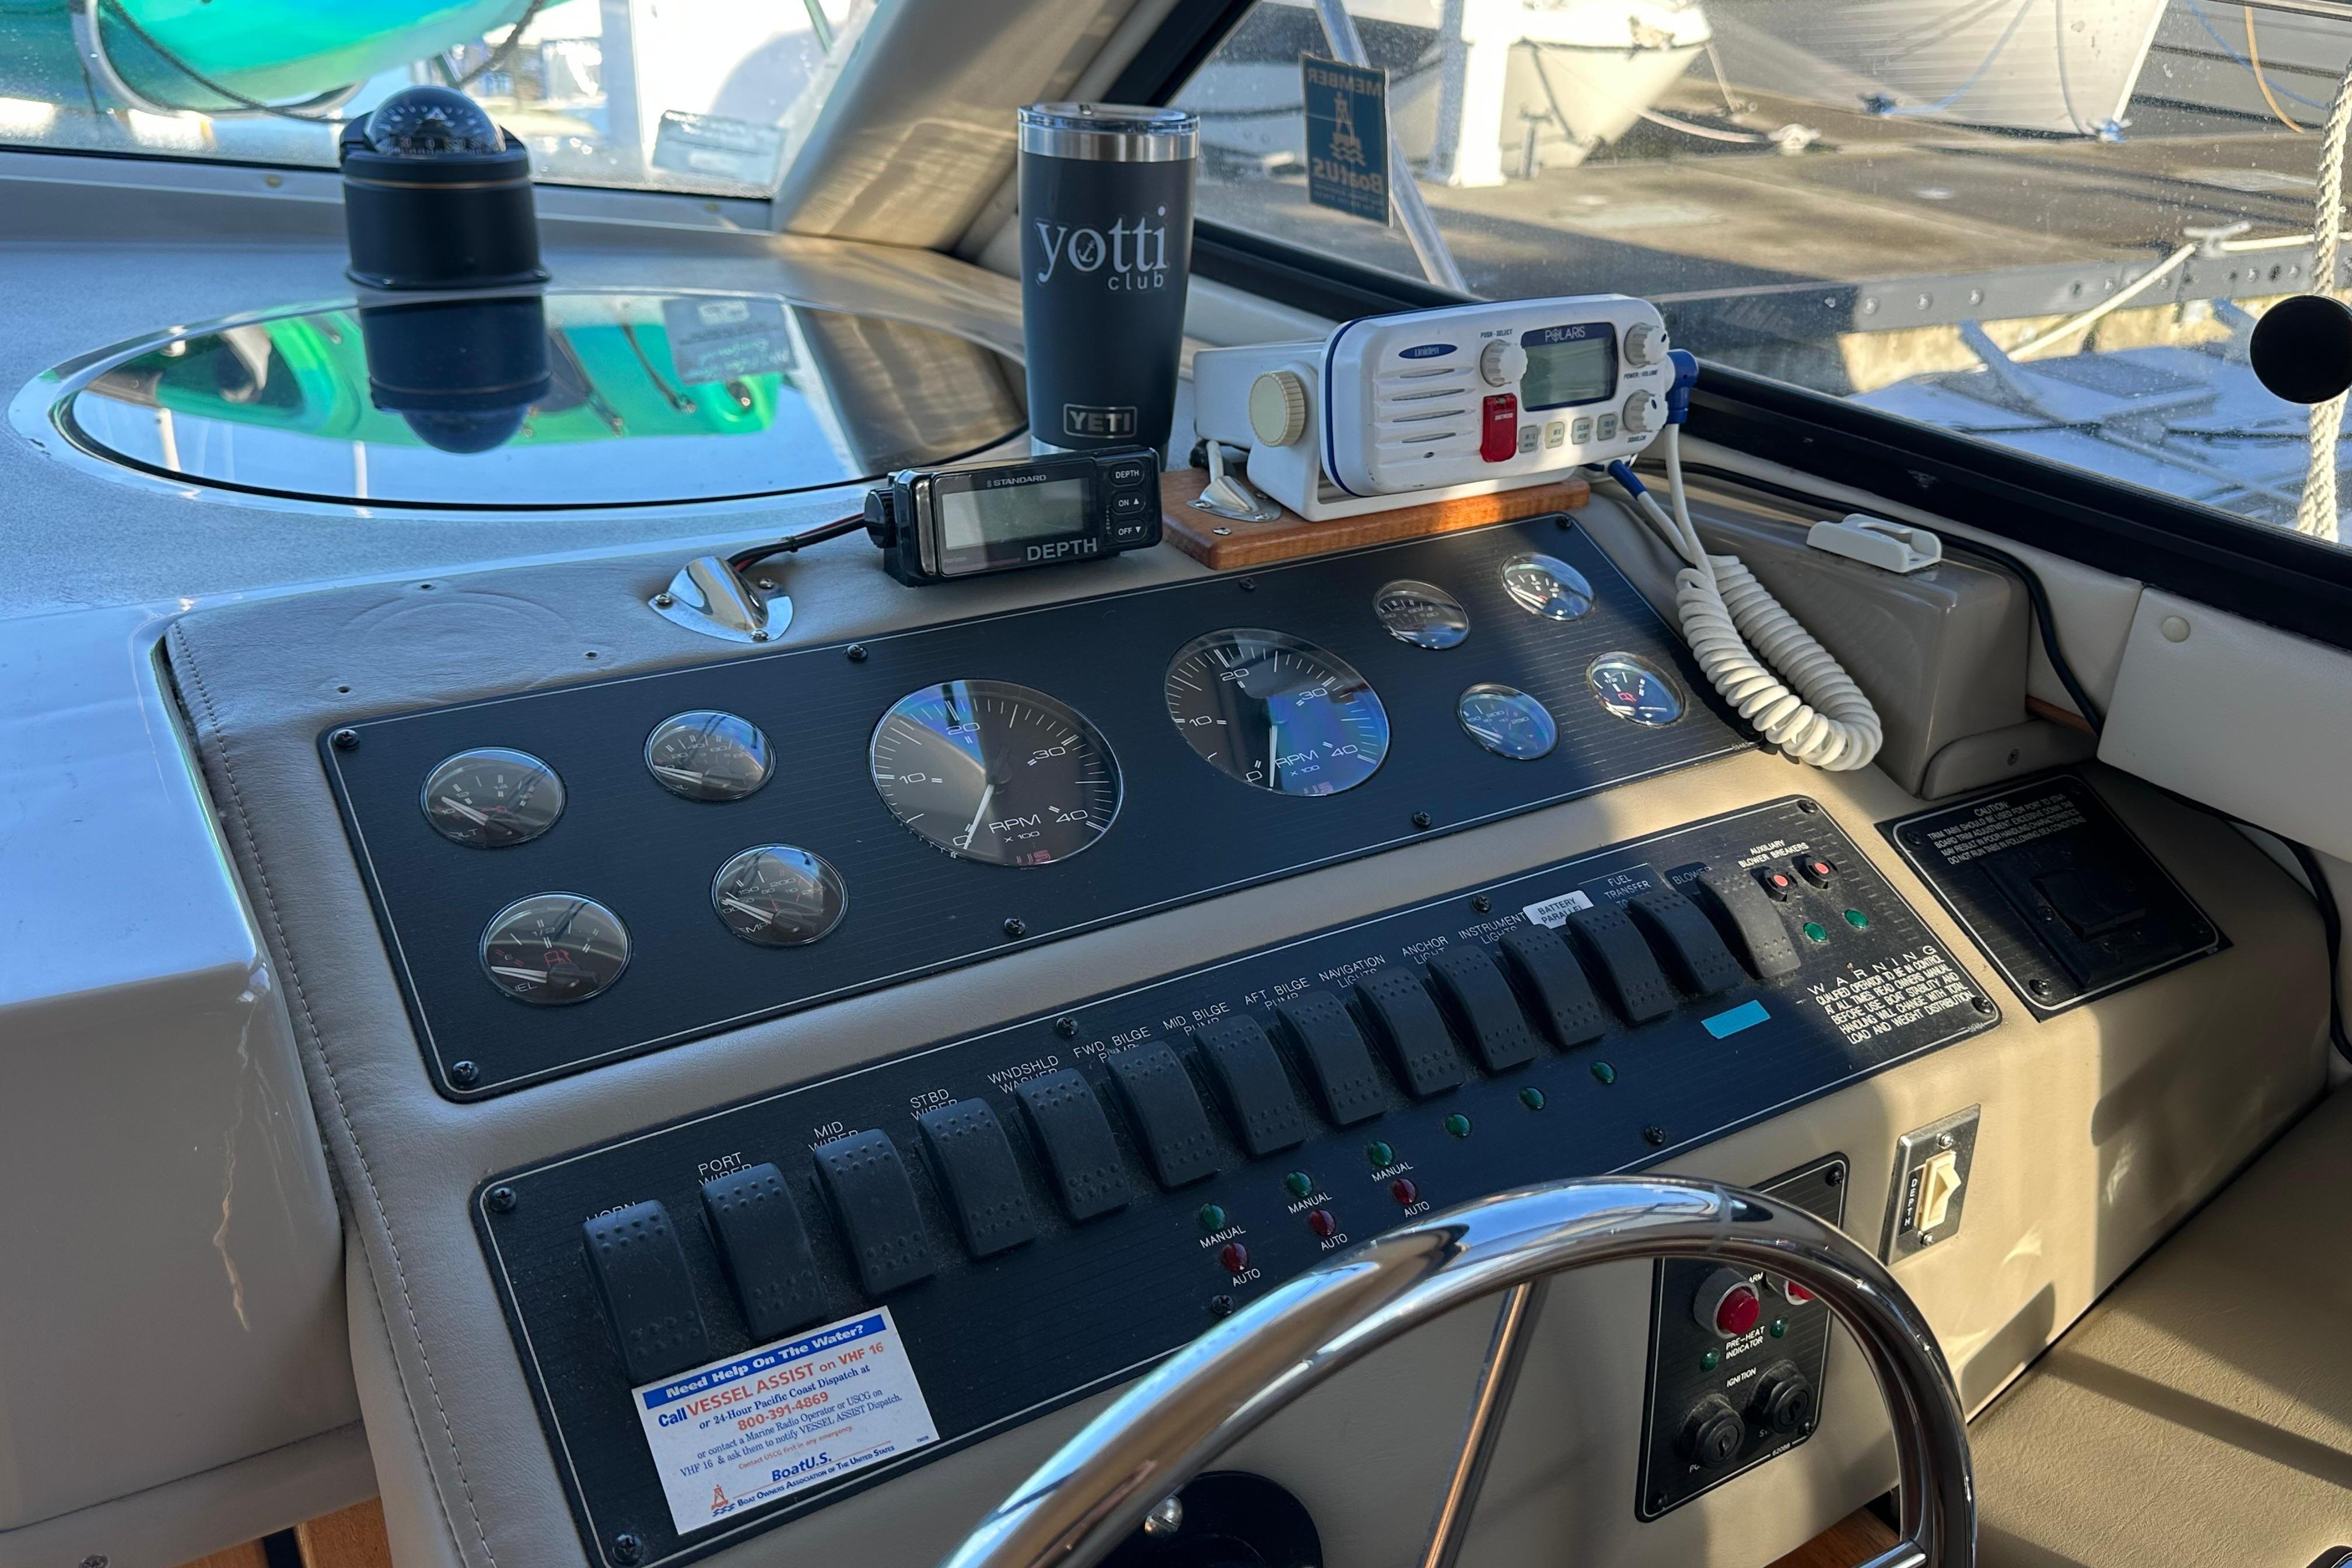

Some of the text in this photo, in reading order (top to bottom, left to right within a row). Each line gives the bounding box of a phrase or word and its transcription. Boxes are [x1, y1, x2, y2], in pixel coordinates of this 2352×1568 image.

[1036, 206, 1167, 282] yotti
[1108, 271, 1164, 290] club
[1545, 326, 1586, 342] POLARIS
[1415, 346, 1439, 356] Uniden
[1070, 411, 1130, 432] YETI
[993, 474, 1046, 487] STANDARD
[1115, 470, 1139, 479] DEPTH
[1118, 527, 1133, 536] OFF
[1027, 538, 1097, 561] DEPTH
[1220, 668, 1249, 681] 20
[1298, 688, 1328, 699] 30
[947, 722, 980, 735] 20
[1189, 715, 1212, 727] 10
[1032, 747, 1066, 760] 30
[1274, 750, 1319, 769] RPM
[1331, 744, 1358, 757] 40
[899, 773, 926, 784] 10
[1246, 770, 1262, 782] 0
[988, 814, 1041, 834] RPM
[1055, 809, 1088, 822] 40
[1926, 801, 2041, 841] TRIM TABS SHOULD USED PORT
[1017, 831, 1040, 839] 100
[1933, 810, 2045, 849] BOARD TRIM EXCESSIVE
[1750, 839, 1786, 855] AUXILIARY
[1940, 824, 2031, 857] MAY RESULT POOR HANDLING
[1969, 830, 2041, 858] RUN TABS FOLLOWING
[1738, 842, 1810, 869] BLOWER BREAKERS
[738, 886, 760, 895] 150
[769, 877, 796, 887] 200
[1604, 880, 1651, 900] TRANSFER
[1607, 874, 1633, 887] FUEL
[1538, 898, 1576, 915] BATTERY
[1458, 912, 1527, 940] INSTRUMENT
[1402, 936, 1449, 957] ANCHOR
[1318, 954, 1386, 982] NAVIGATION
[1807, 945, 1937, 995] WARNING
[1815, 954, 1945, 1006] QUALIFIED OPERATOR TO BE IN CONTROL
[1824, 964, 1953, 1016] AT ALL READ OWNERS MANUAL
[1244, 990, 1267, 1005] AFT
[1274, 977, 1310, 995] BILGE
[1831, 972, 1961, 1026] BEFORE BOAT STABILITY AND
[1163, 1016, 1186, 1030] MID
[1192, 1002, 1230, 1021] BILGE
[1838, 981, 1969, 1035] HANDLING WILL CHANGE WITH TOTAL
[1846, 1030, 1872, 1045] LOAD
[1873, 1022, 1892, 1035] AND
[1890, 1009, 1925, 1028] WEIGHT
[1073, 1041, 1105, 1058] FWD
[1112, 1027, 1152, 1046] BILGE
[988, 1055, 1059, 1084] WNDSHLD
[910, 1083, 950, 1102] STBD
[814, 1121, 844, 1139] MID
[698, 1152, 742, 1176] PORT
[1371, 1161, 1414, 1182] MANUAL
[1287, 1192, 1333, 1214] MANUAL
[1404, 1201, 1430, 1218] AUTO
[1904, 1178, 1917, 1226] DEPTH
[1199, 1225, 1247, 1249] MANUAL
[1321, 1233, 1348, 1251] AUTO
[1233, 1268, 1261, 1287] AUTO
[1726, 1326, 1765, 1350] PRE-HEAT
[1726, 1336, 1763, 1360] INDICATOR
[666, 1324, 864, 1398] Need Help On The Water?
[659, 1342, 884, 1427] Call VESSEL ASSIST on VHF 16
[1727, 1367, 1756, 1388] IGNITION
[699, 1364, 870, 1429] or 24-Hour Pacific Coast Dispatch at
[737, 1391, 828, 1431] 800-391-4869
[708, 1439, 738, 1455] contact
[746, 1426, 775, 1442] Marine
[775, 1416, 799, 1431] Radio
[800, 1405, 835, 1423] Operator
[837, 1401, 845, 1409] or
[846, 1391, 872, 1406] USCG
[873, 1389, 883, 1397] on
[680, 1394, 902, 1478] VHF 16 & ask them to notify VESSEL ASSIST Dispatch.
[738, 1457, 763, 1469] Contact
[765, 1450, 782, 1460] USCG
[806, 1438, 817, 1447] any
[772, 1452, 832, 1482] BoatU.S.
